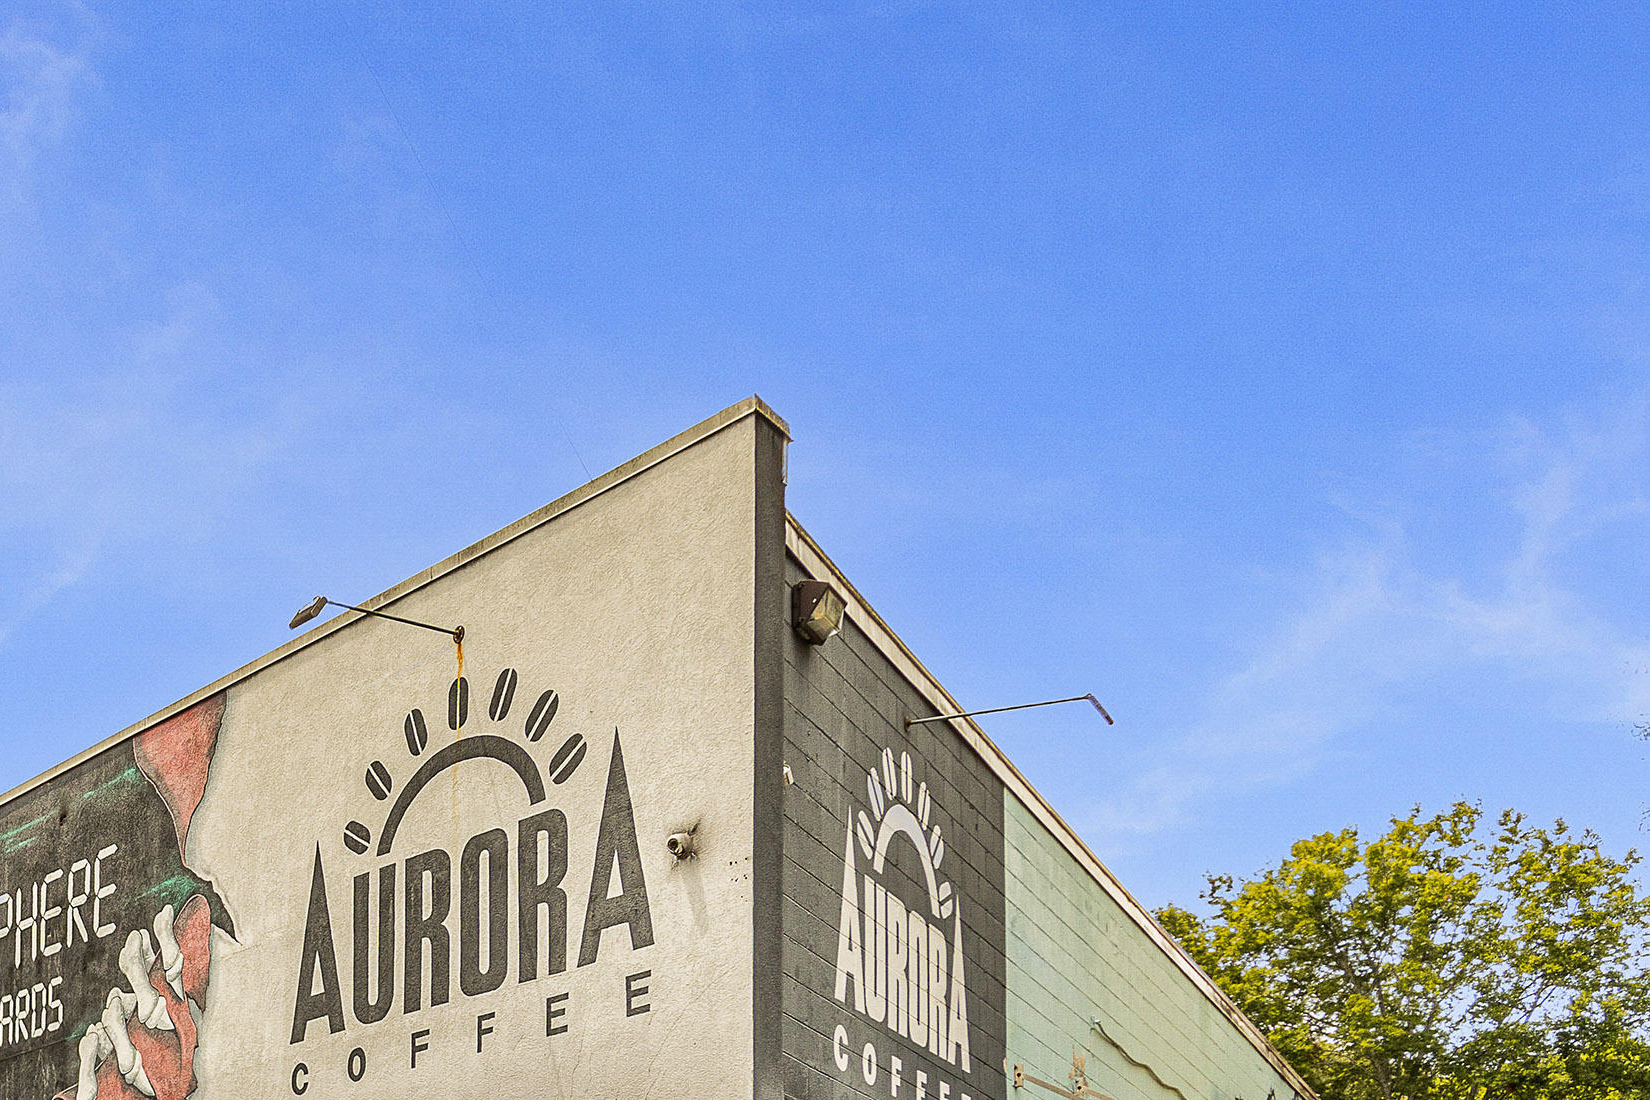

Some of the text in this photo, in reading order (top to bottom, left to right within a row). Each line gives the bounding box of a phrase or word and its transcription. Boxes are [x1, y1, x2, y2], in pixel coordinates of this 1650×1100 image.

[290, 726, 655, 1046] AURORA
[834, 804, 971, 1074] AURORA
[291, 969, 653, 1096] COFFEE
